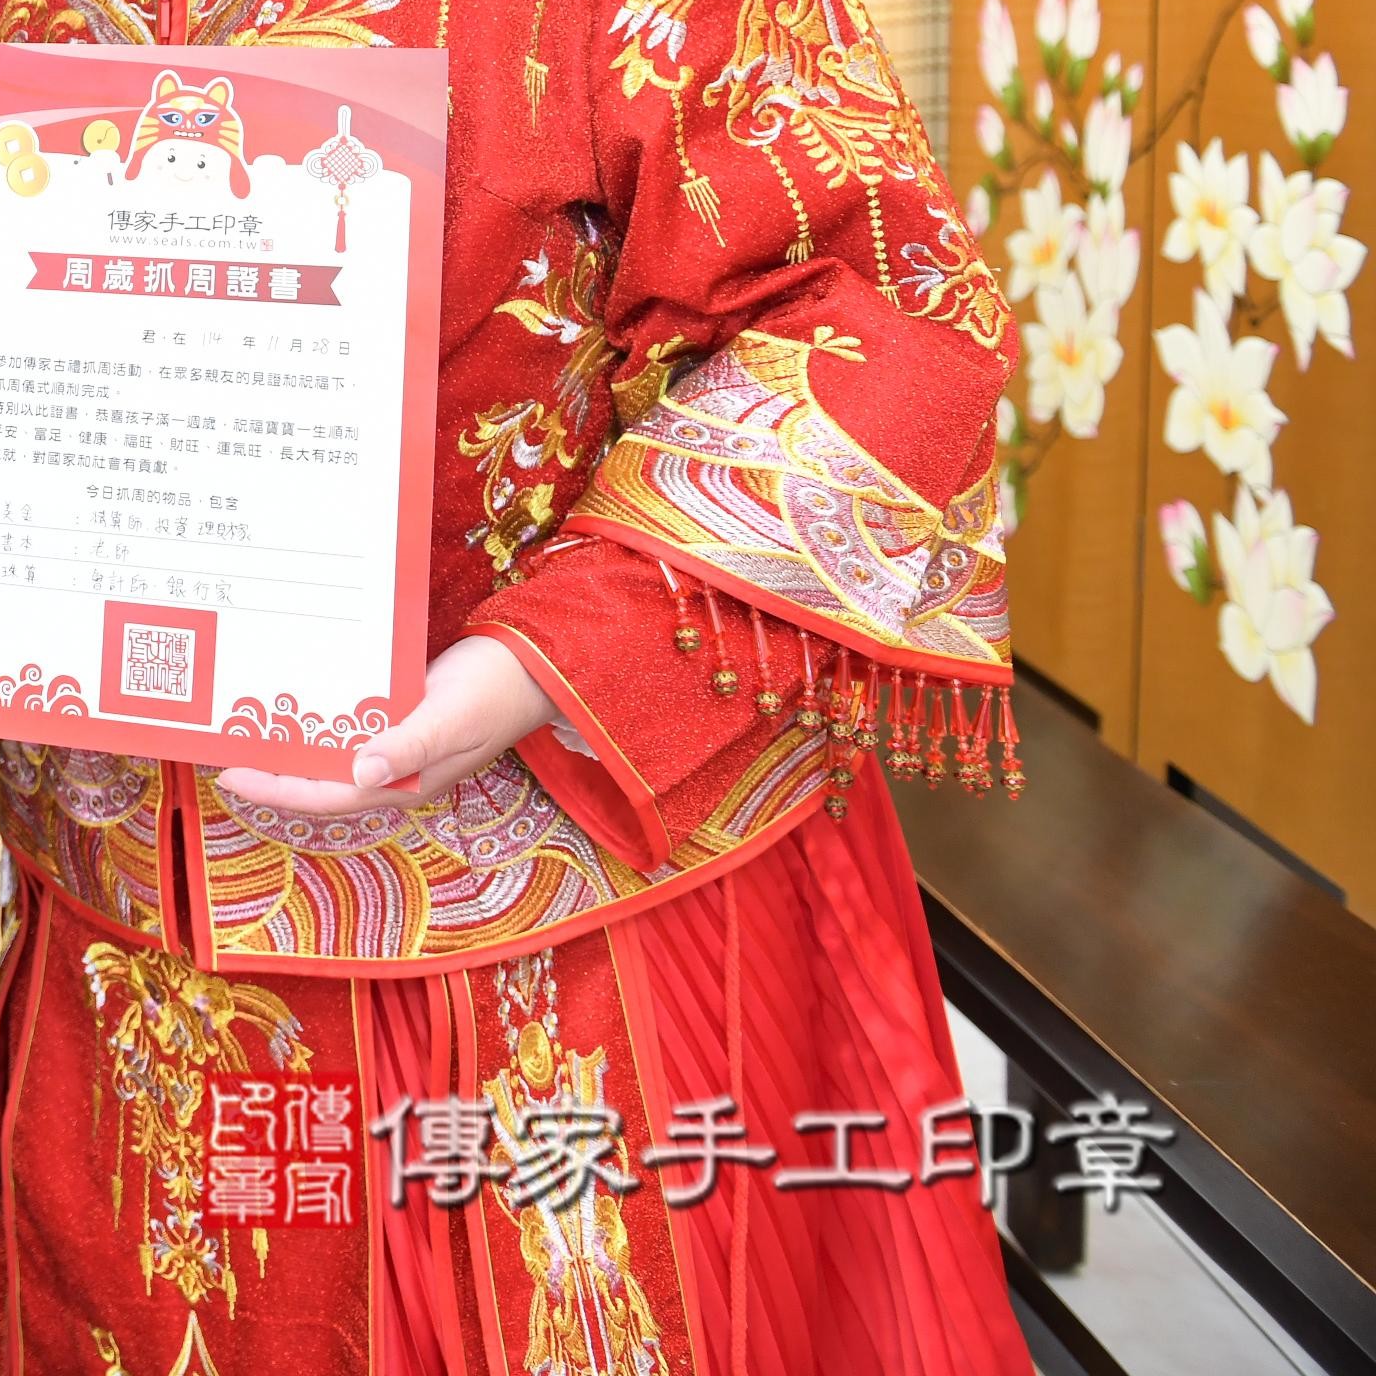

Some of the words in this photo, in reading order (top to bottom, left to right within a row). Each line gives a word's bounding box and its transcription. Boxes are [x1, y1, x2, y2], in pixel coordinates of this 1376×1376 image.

[107, 209, 263, 237] 傳家手工印章
[109, 234, 257, 251] www.seals.com.tw
[62, 256, 302, 301] 周歲抓周證書
[243, 335, 256, 350] 年
[290, 338, 303, 353] 月
[338, 341, 350, 355] 日
[90, 538, 130, 563] 老師
